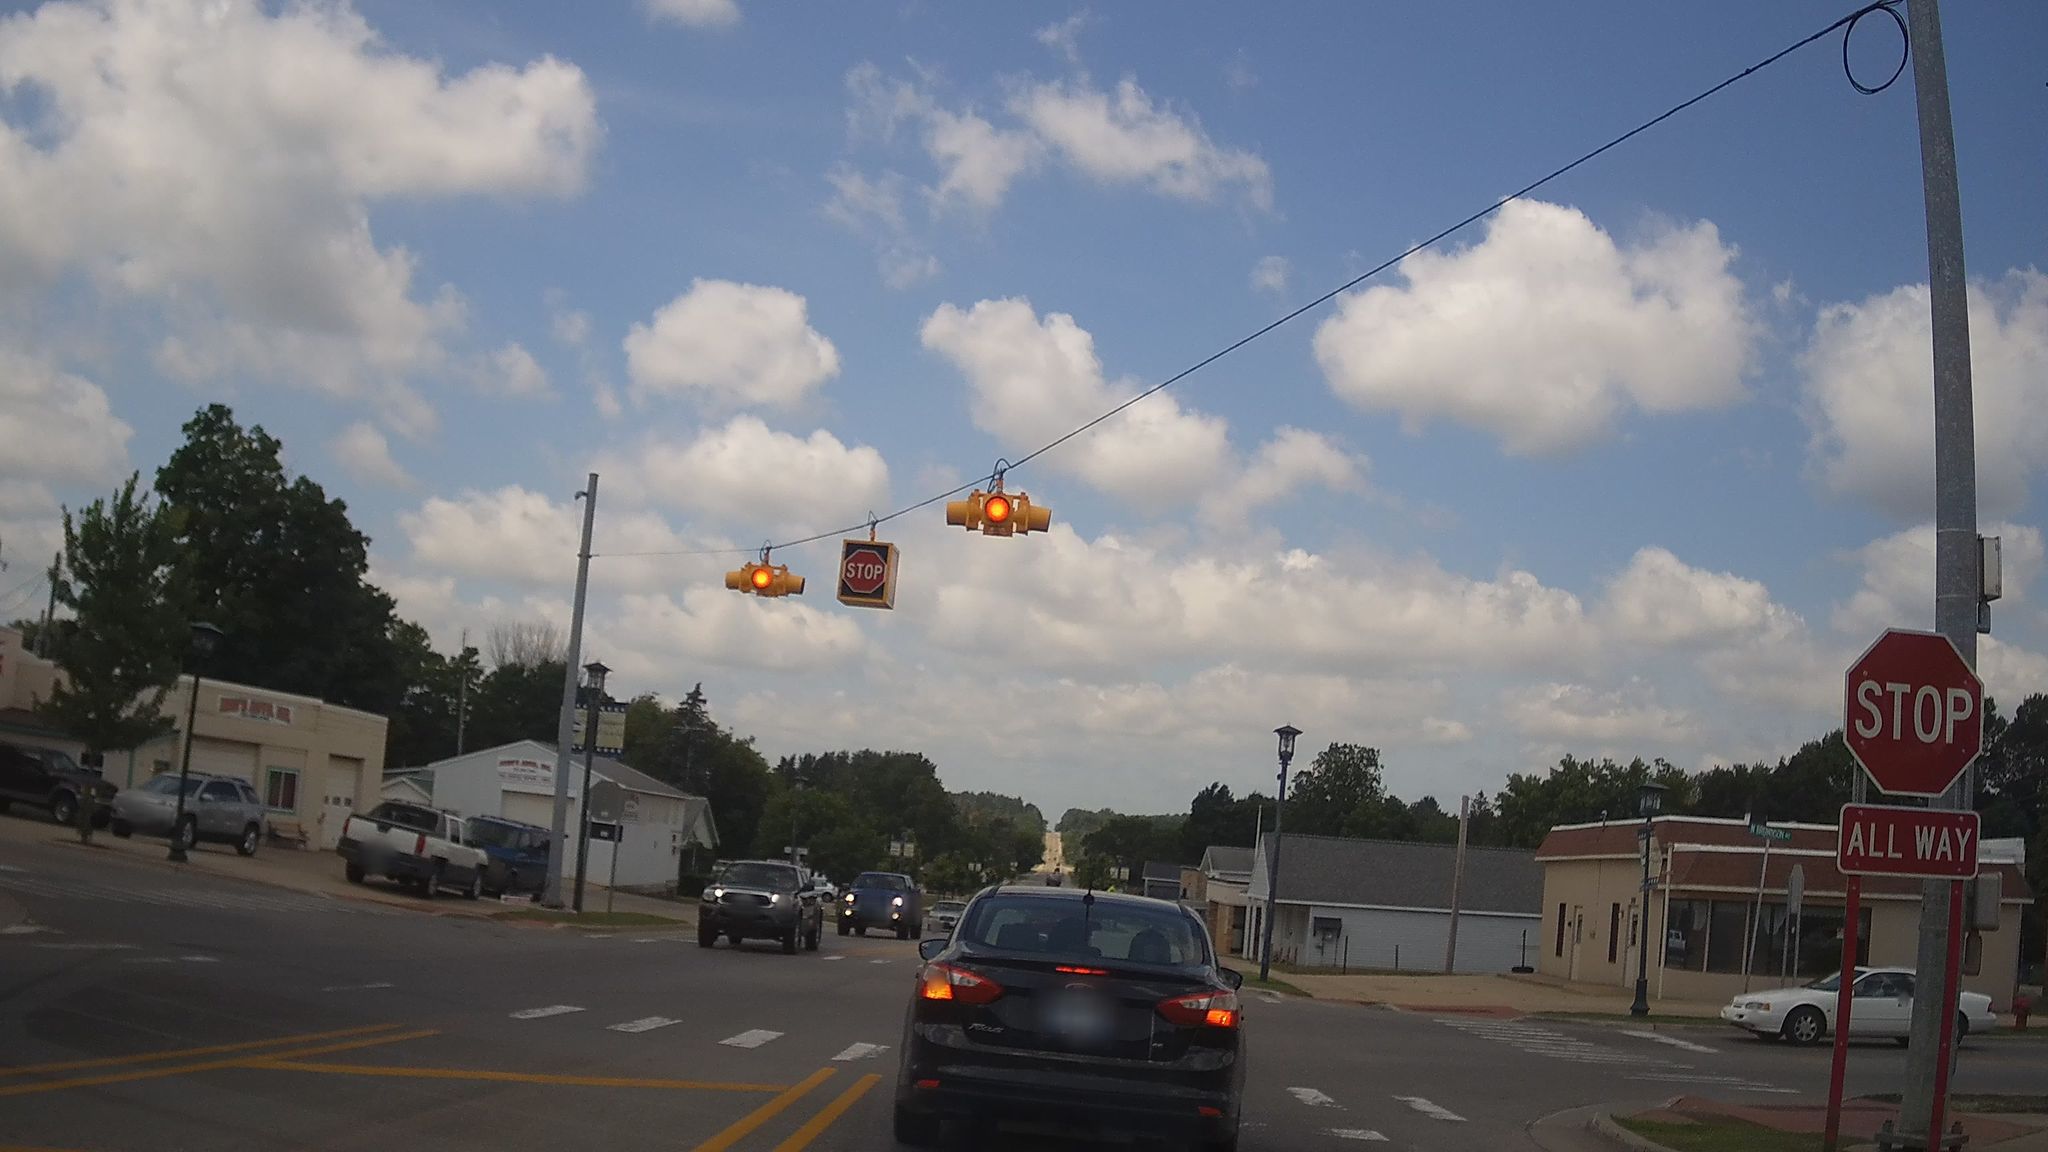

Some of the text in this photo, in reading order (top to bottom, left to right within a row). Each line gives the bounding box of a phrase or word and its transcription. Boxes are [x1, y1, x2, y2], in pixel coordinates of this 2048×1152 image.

[846, 563, 883, 580] STOP
[1855, 679, 1973, 744] STOP
[1846, 821, 1972, 862] ALL WAY
